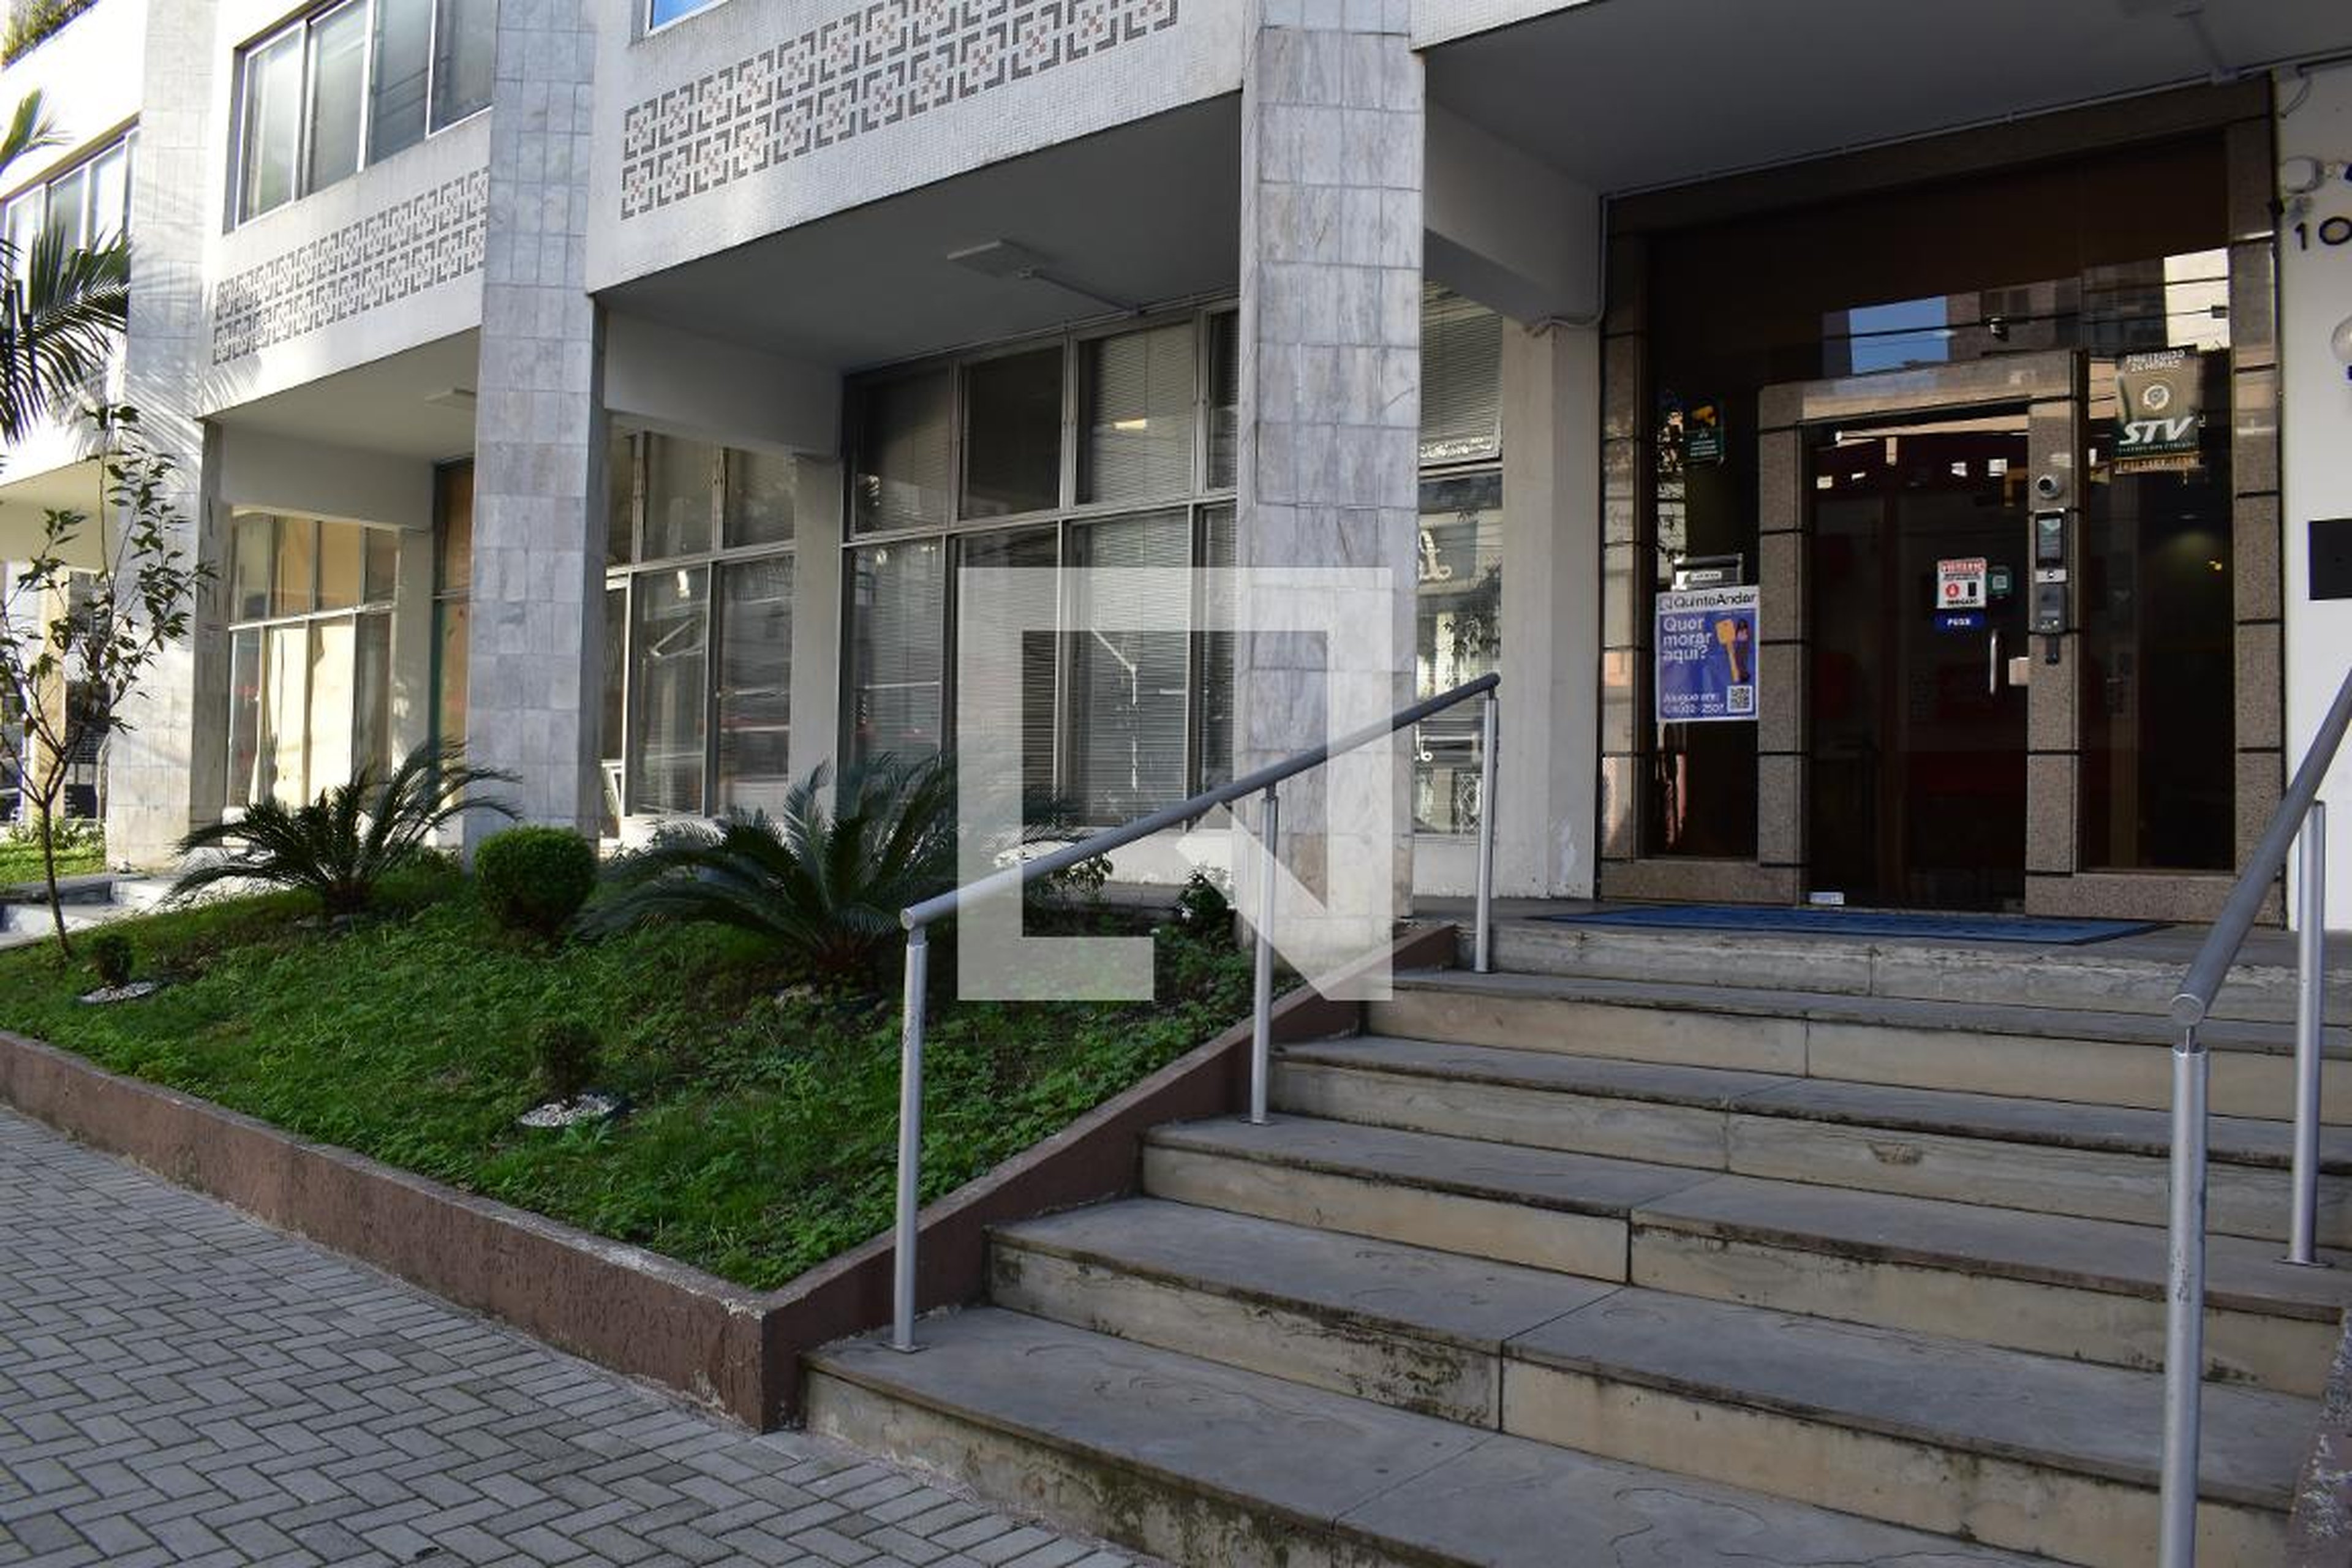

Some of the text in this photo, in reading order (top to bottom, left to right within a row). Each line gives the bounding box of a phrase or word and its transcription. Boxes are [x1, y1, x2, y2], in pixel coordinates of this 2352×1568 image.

[2119, 417, 2194, 445] STV
[1673, 592, 1756, 609] QuintoAndar
[1663, 616, 1705, 633] Quer
[1662, 631, 1712, 647] morar
[1662, 644, 1708, 664] aqui?
